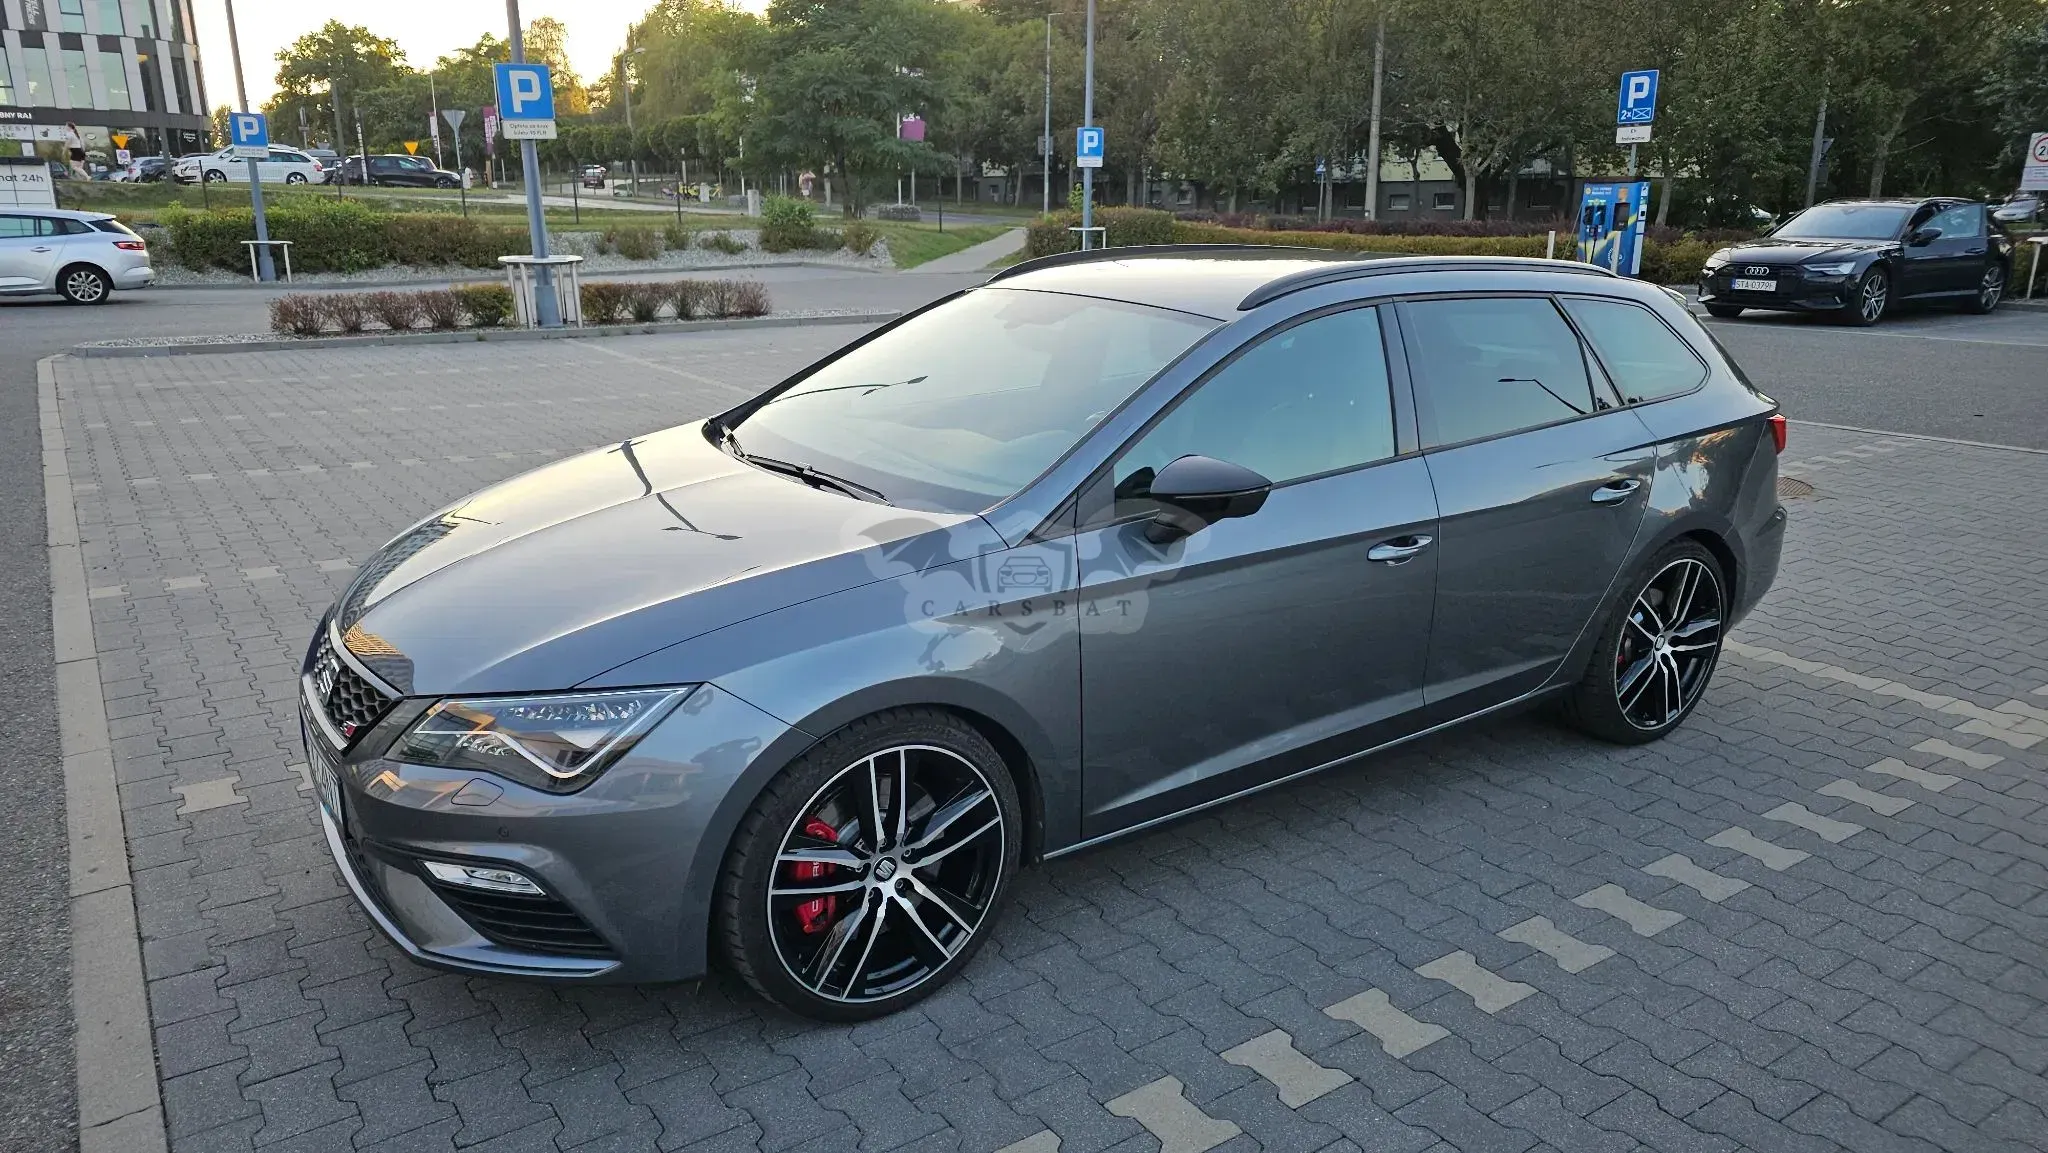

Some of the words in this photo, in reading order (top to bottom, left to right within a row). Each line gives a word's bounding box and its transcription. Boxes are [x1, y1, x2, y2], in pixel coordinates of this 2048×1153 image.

[509, 70, 541, 113] P
[1627, 76, 1650, 108] P
[238, 116, 259, 142] P
[1083, 131, 1098, 153] P
[2038, 145, 2048, 156] 2
[21, 174, 44, 182] 24h
